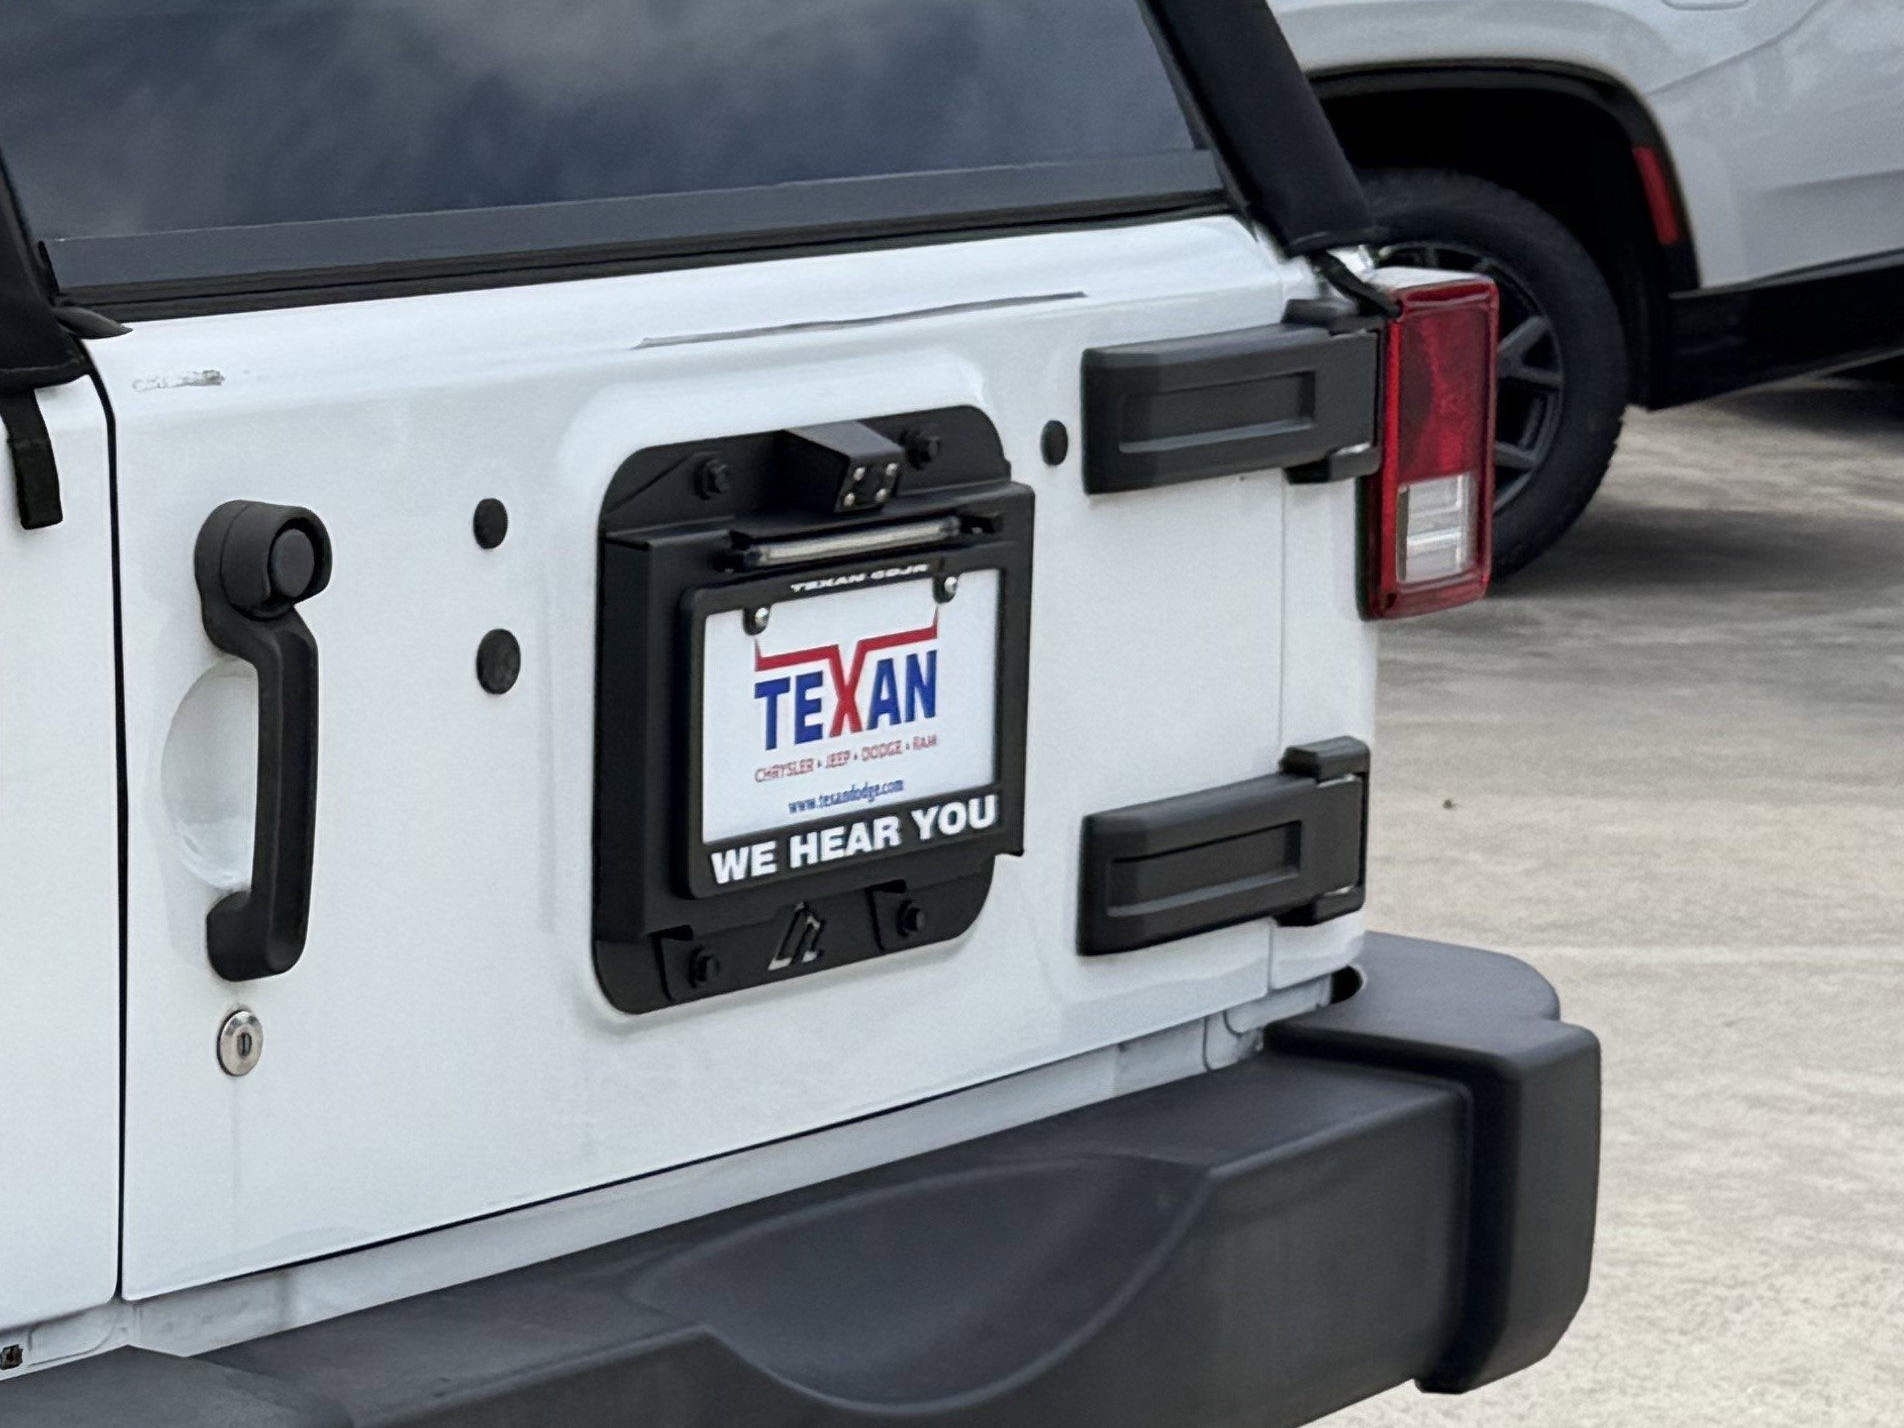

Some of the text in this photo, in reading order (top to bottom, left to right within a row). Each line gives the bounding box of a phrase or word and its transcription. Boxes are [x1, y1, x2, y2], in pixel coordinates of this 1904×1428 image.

[790, 572, 867, 593] TEXAN
[753, 626, 938, 751] TEXAN
[754, 733, 938, 784] CHRYSLER JEEP DODGE RAM
[788, 778, 905, 815] www.texandodge.com
[711, 794, 999, 885] WE HEAR YOU
